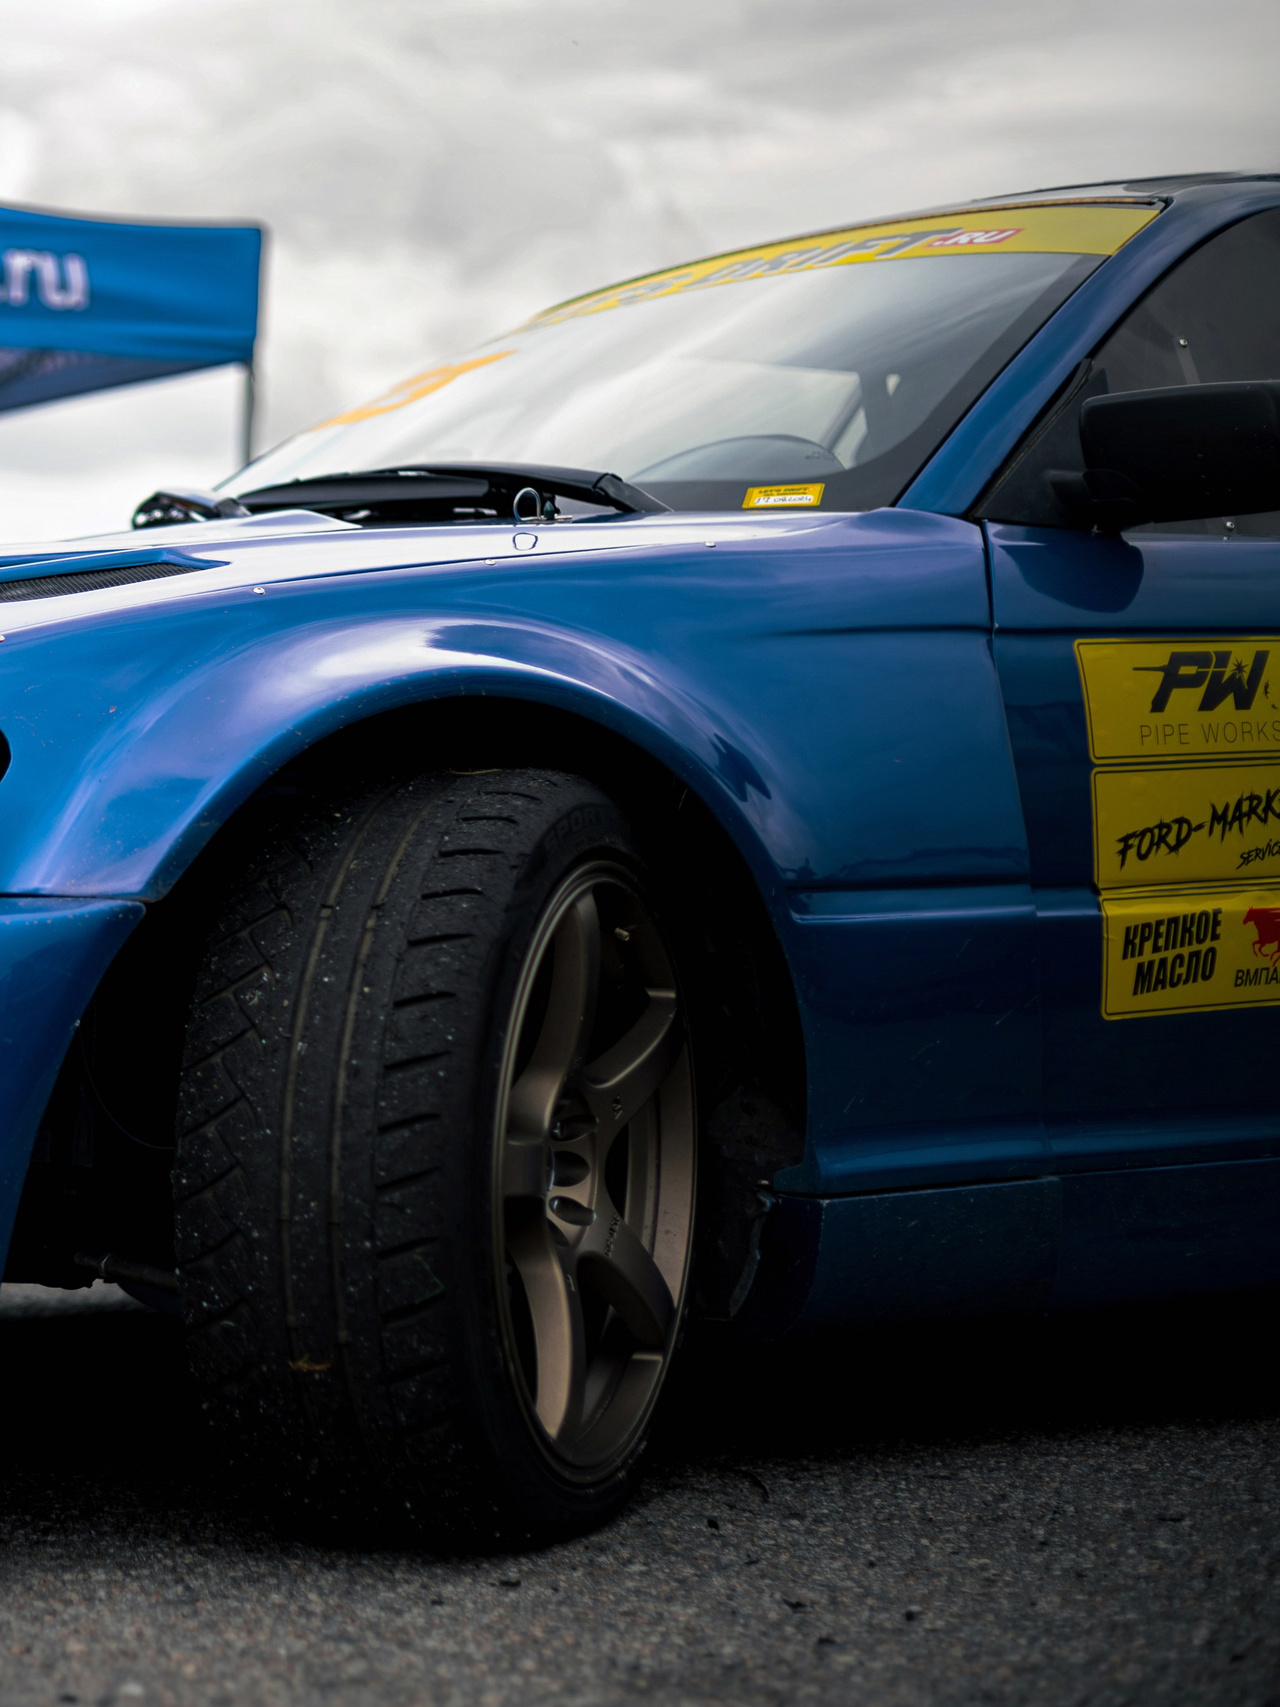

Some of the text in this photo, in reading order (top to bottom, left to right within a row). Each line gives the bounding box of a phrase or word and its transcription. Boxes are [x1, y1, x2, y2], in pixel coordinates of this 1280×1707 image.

[1139, 723, 1190, 746] PIPE
[1116, 788, 1280, 872] FORD-MARK
[1122, 907, 1222, 960] КРЕПКОЕ
[1133, 946, 1218, 996] МАСЛО
[1234, 966, 1280, 988] ВМПА
